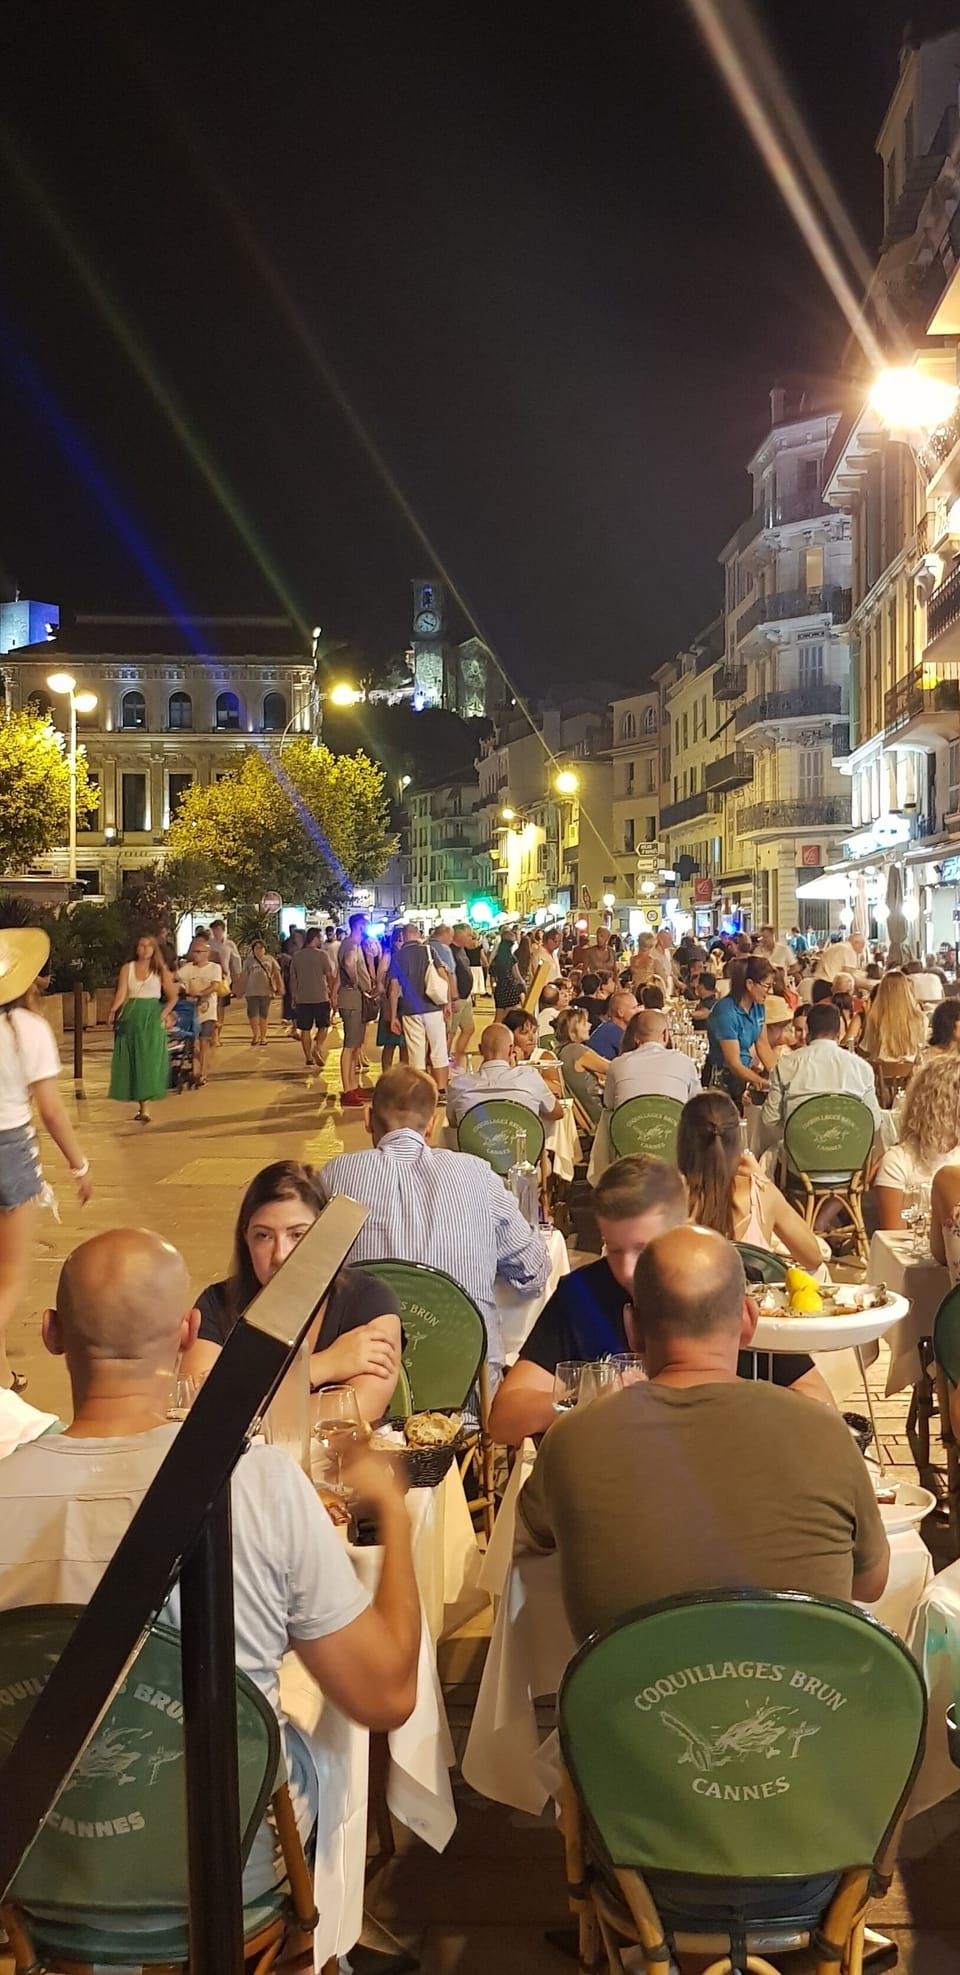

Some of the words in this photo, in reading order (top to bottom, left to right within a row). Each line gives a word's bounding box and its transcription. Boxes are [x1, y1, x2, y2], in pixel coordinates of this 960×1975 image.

[411, 1304, 440, 1326] BRUN
[634, 1661, 787, 1711] COQUILLAGES
[789, 1671, 847, 1711] BRUN
[134, 1683, 184, 1725] BRU
[692, 1776, 791, 1801] CANNES
[47, 1810, 146, 1837] CANNES
